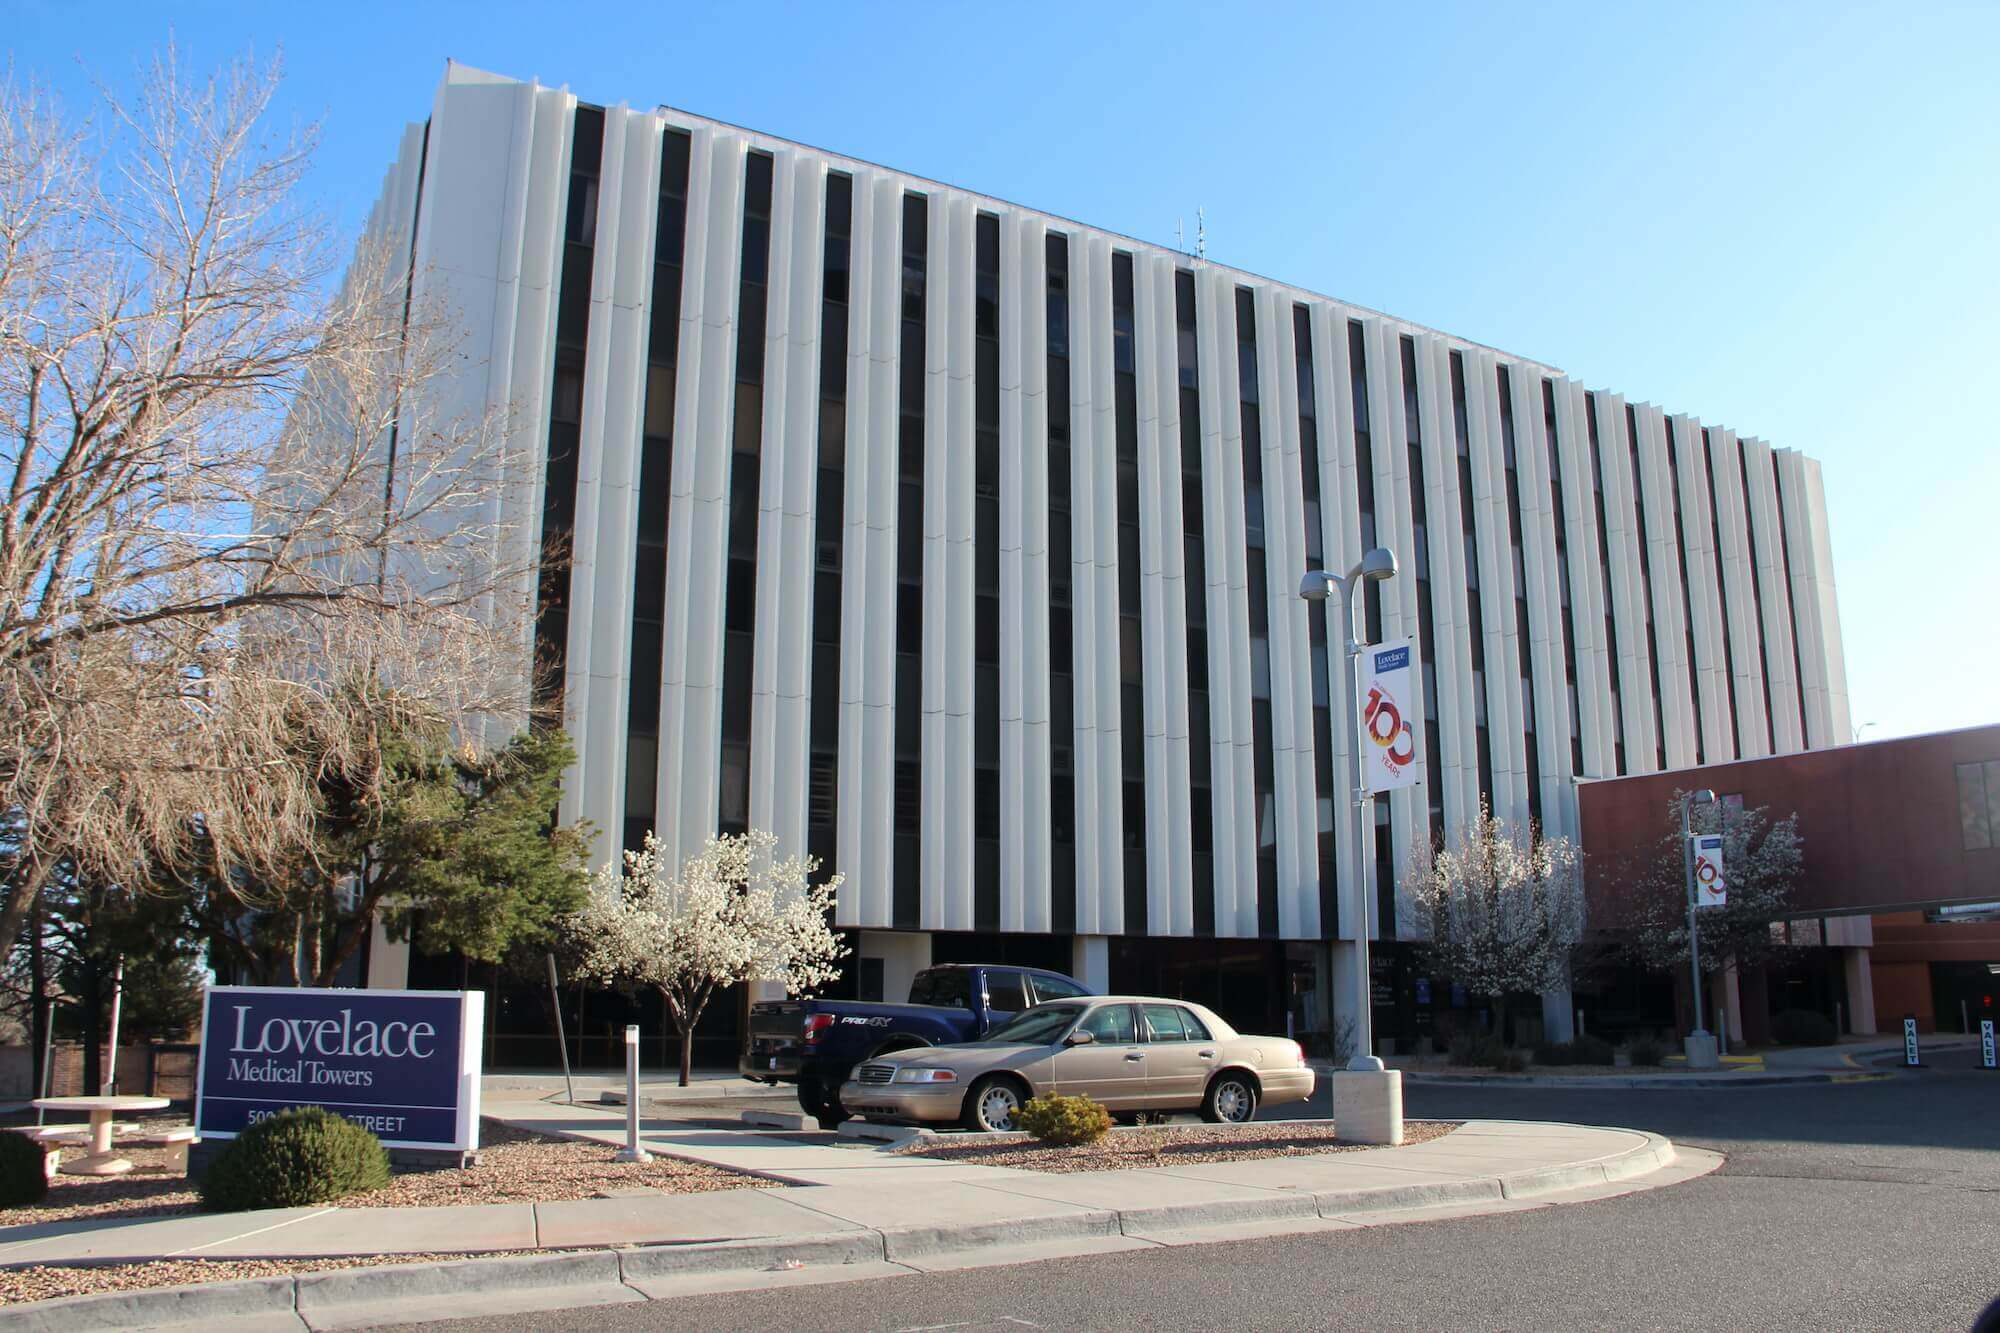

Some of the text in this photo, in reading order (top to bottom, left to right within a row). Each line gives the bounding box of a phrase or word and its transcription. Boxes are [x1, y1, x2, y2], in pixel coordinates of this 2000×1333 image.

[1381, 754, 1401, 779] YEARS
[229, 1005, 436, 1059] Lovelace
[1905, 1021, 1917, 1063] VALET
[1983, 1023, 1993, 1065] VALET
[226, 1057, 373, 1087] Medical Towers
[347, 1114, 406, 1132] TREET
